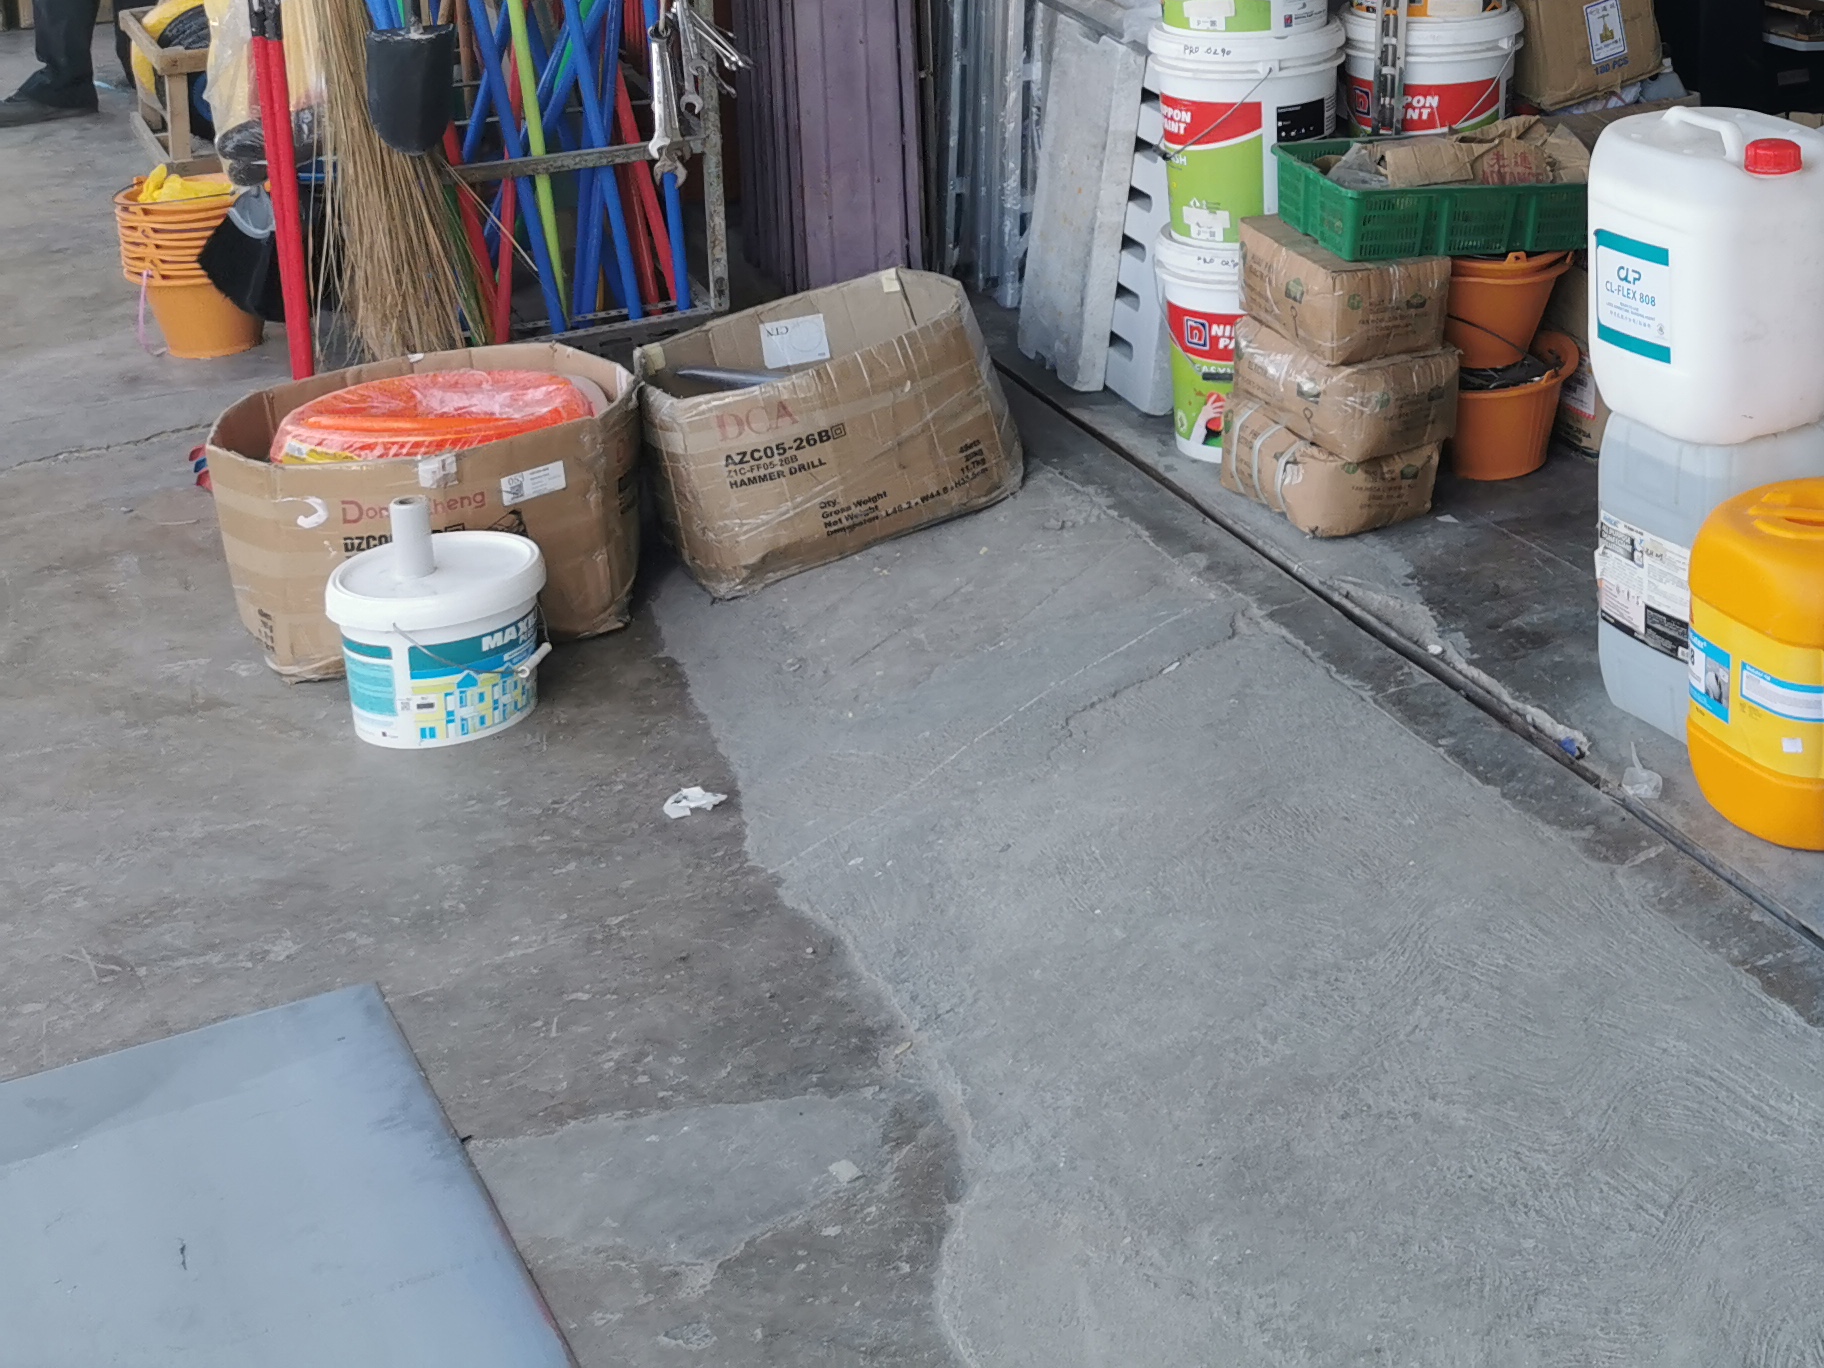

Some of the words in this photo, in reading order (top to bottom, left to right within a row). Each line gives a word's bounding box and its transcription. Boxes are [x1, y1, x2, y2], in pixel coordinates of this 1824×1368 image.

[1605, 280, 1637, 302] CL-FLEX
[1639, 292, 1656, 307] 808
[766, 326, 790, 338] CTN
[715, 400, 800, 442] DCA
[724, 428, 832, 468] AZC05-26B
[729, 469, 786, 490] HAMMER
[789, 457, 827, 477] DRILL
[821, 503, 852, 520] Gross
[852, 491, 888, 510] Weight
[823, 516, 844, 531] Net
